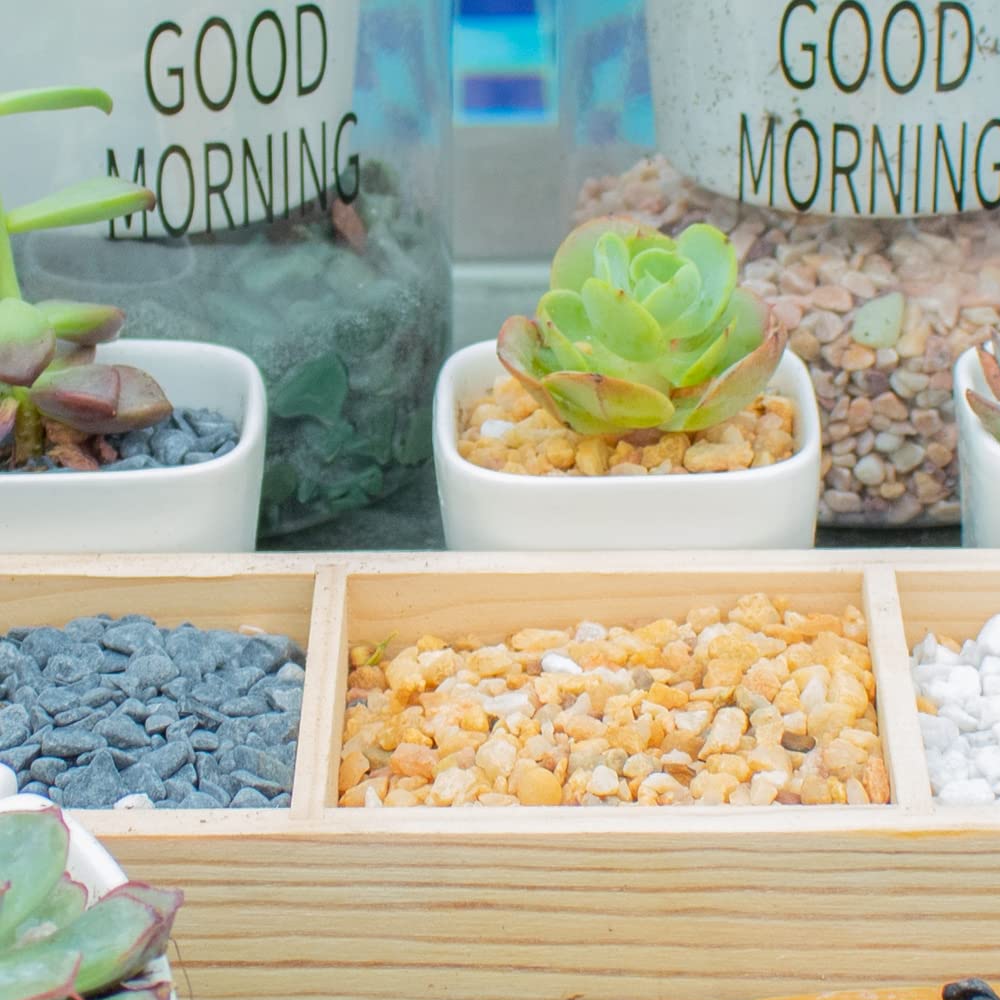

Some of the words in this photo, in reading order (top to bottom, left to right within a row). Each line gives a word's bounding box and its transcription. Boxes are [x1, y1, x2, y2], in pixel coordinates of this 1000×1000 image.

[145, 3, 327, 116] GOOD
[779, 0, 974, 94] GOOD
[106, 112, 360, 241] MORNING
